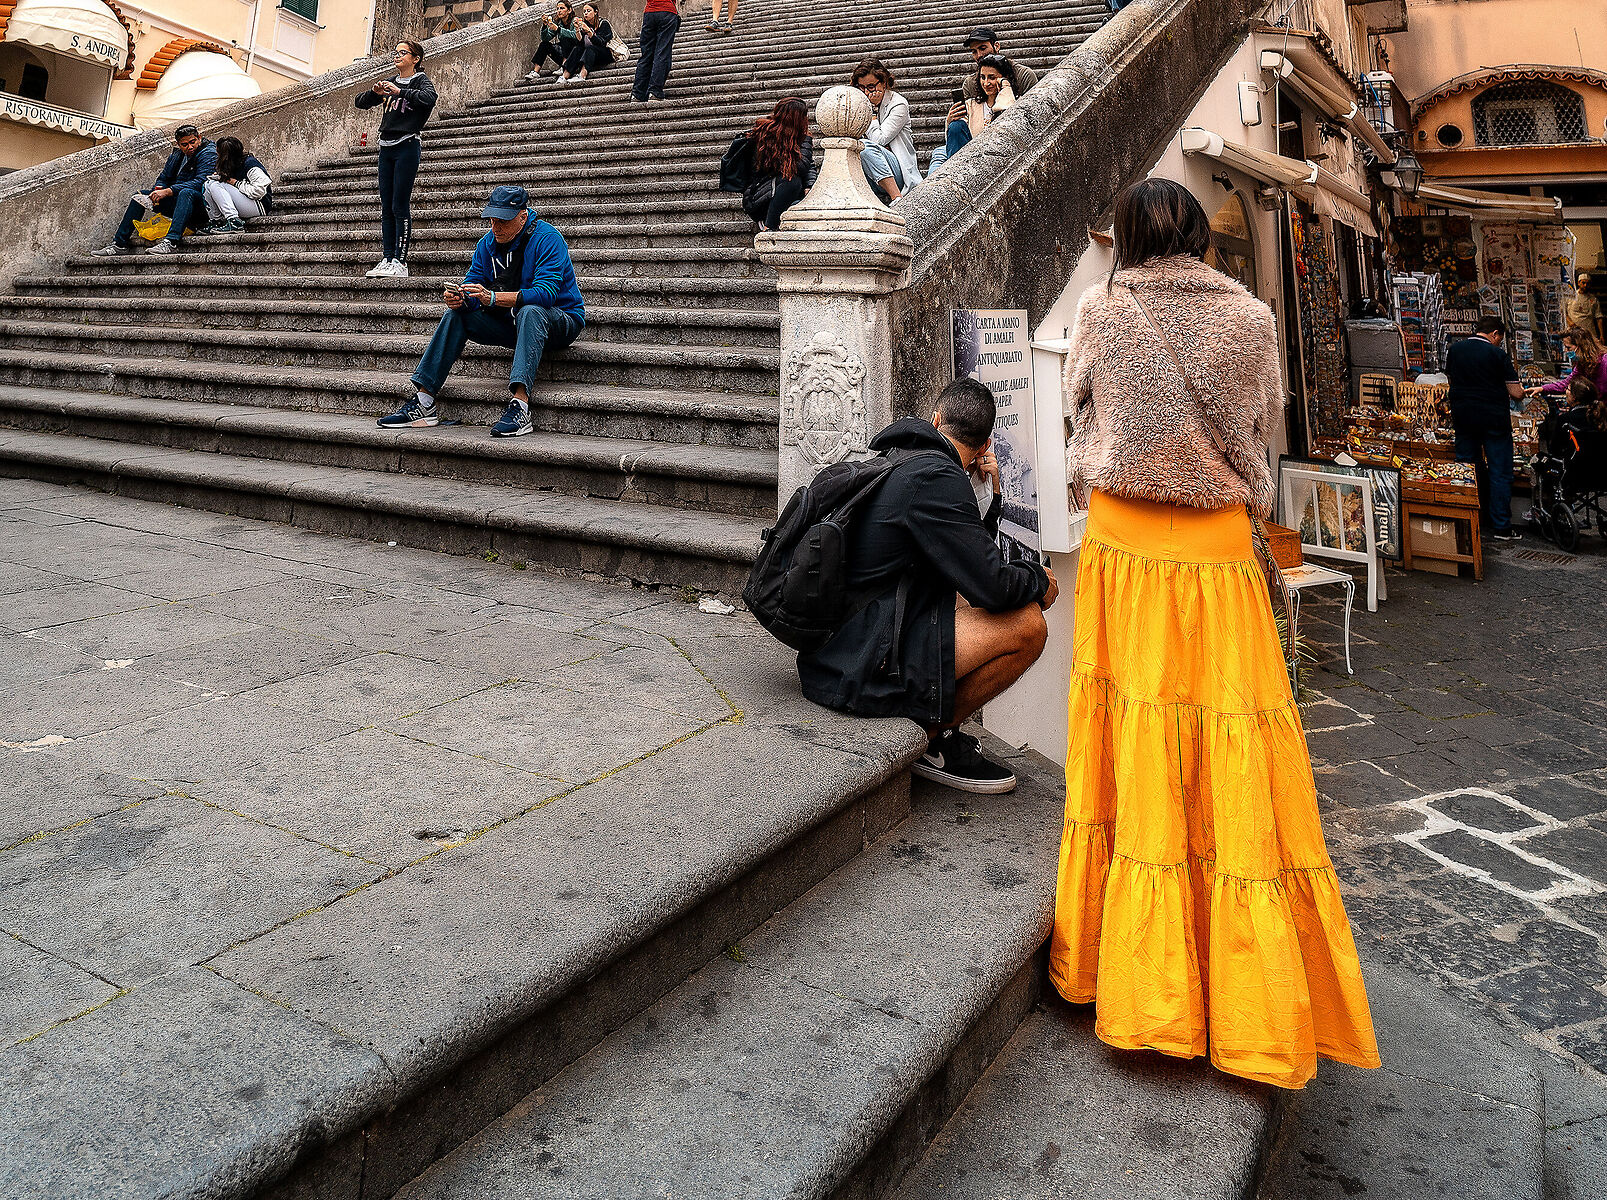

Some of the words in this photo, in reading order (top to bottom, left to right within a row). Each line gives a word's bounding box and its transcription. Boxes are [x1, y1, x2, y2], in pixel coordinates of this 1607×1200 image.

[71, 35, 81, 48] S.
[85, 40, 120, 62] ANDREA
[5, 101, 73, 127] RISTORANTE
[80, 119, 122, 138] PIZZERIA
[975, 317, 996, 330] CARTA
[997, 318, 1001, 329] A
[1002, 317, 1020, 329] MANO
[984, 332, 992, 345] DI
[993, 332, 1015, 344] AMALFI
[977, 350, 1023, 367] ANTIQUARIATO
[983, 379, 1008, 392] NDMADE
[1009, 377, 1029, 390] AMALFI
[994, 395, 1012, 408] PAPER
[994, 414, 1018, 430] NTIQUES
[1374, 501, 1391, 555] Amalfi
